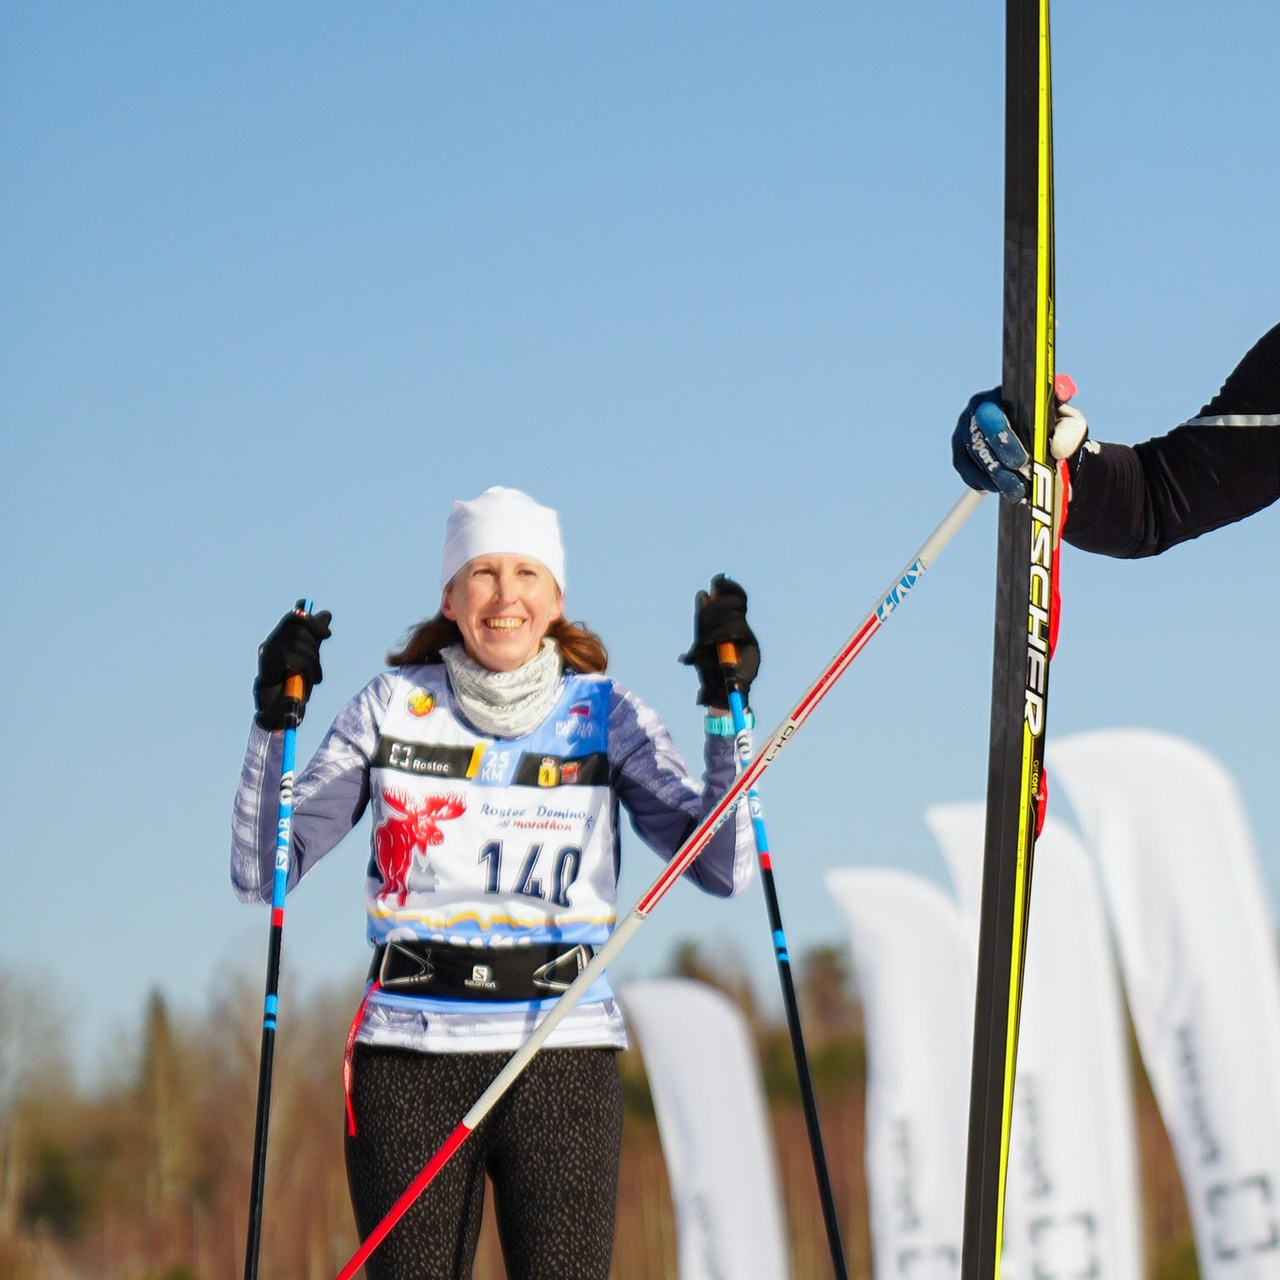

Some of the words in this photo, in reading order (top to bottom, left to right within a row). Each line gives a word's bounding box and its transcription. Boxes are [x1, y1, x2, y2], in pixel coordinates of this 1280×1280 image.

[1022, 460, 1054, 738] FISCHER
[413, 758, 450, 772] Rostec
[486, 750, 511, 770] 25
[536, 805, 586, 820] Demino
[512, 819, 572, 832] marathon
[477, 838, 583, 909] 140
